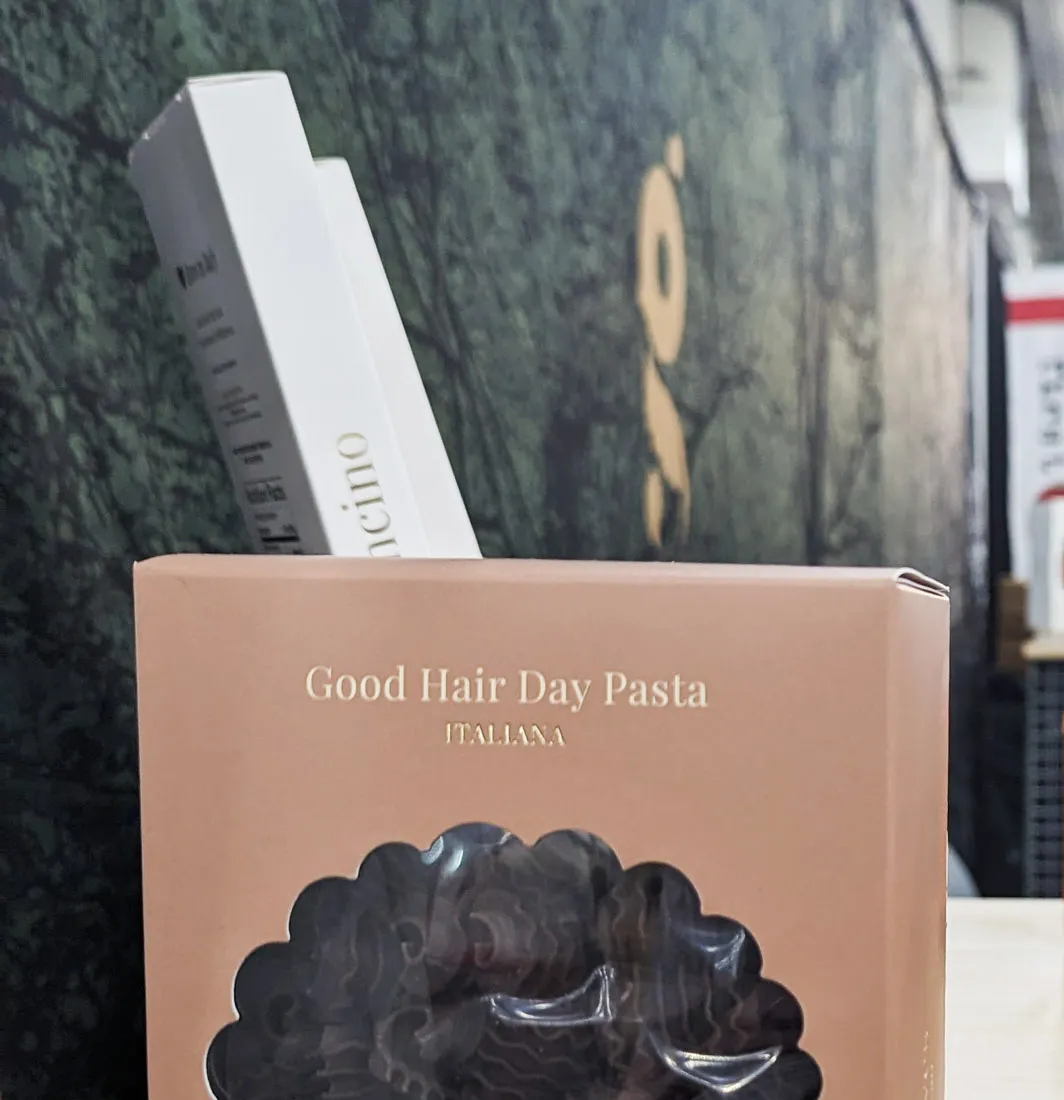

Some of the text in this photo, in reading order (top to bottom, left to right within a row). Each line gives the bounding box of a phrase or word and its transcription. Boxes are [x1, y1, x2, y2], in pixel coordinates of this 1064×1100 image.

[304, 664, 710, 714] Good Hair Day Pasta
[444, 721, 567, 747] ITALIANA
